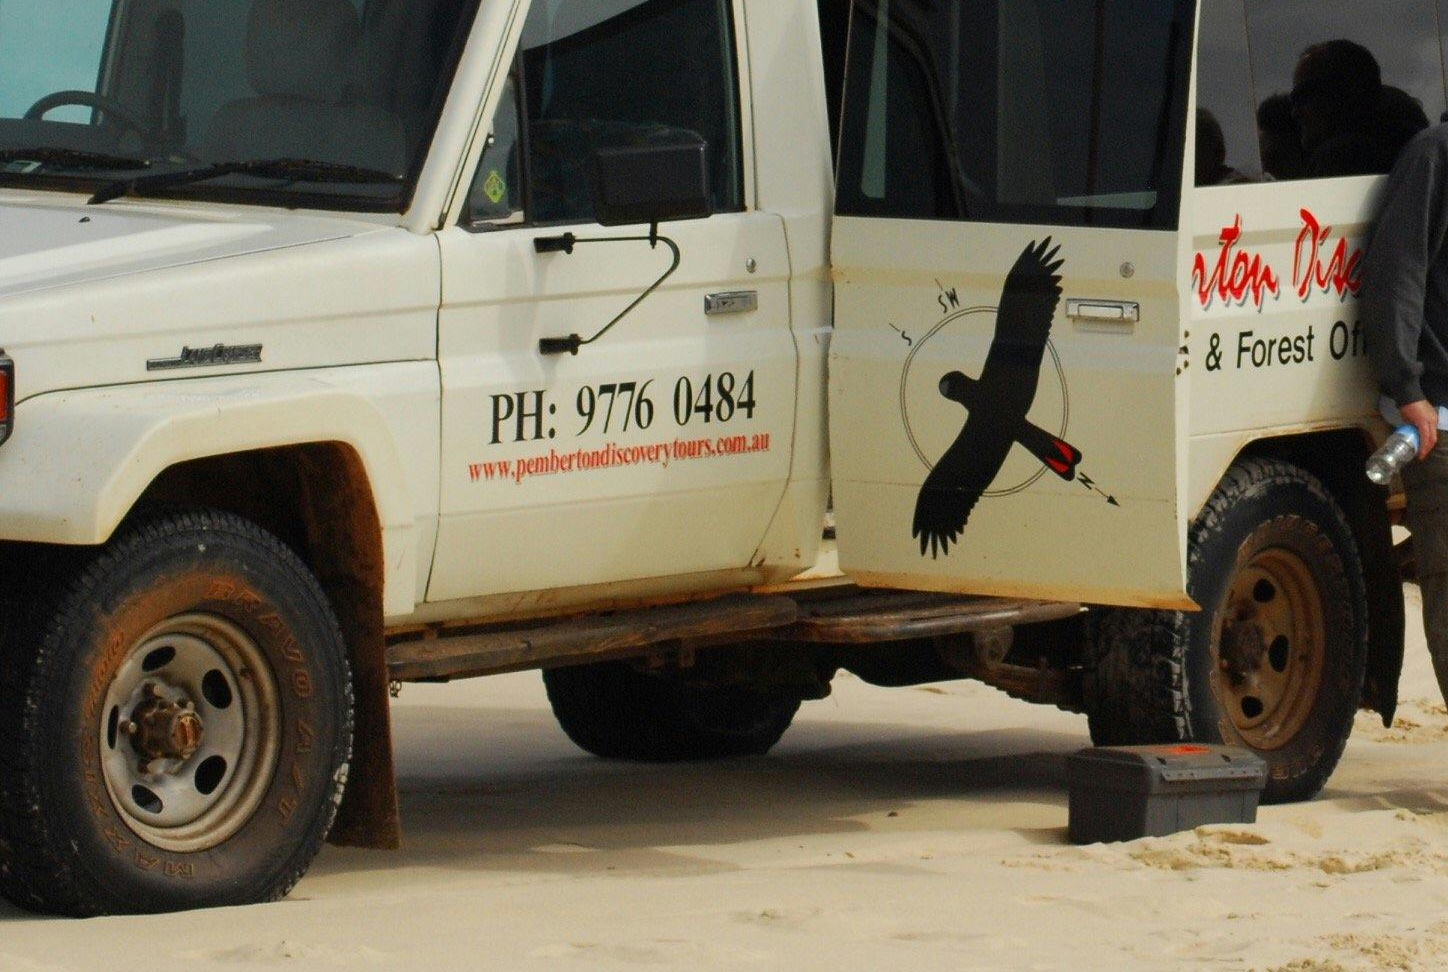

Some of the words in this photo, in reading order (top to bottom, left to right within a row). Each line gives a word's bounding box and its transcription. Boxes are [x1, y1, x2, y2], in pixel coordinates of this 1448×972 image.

[1205, 332, 1223, 372] &
[1236, 325, 1315, 369] Forest
[1329, 320, 1367, 361] Of
[488, 389, 556, 445] PH:
[575, 378, 655, 436] 9776
[673, 369, 757, 426] 0484
[467, 431, 771, 484] www.pembertondiscoverytours.com.au
